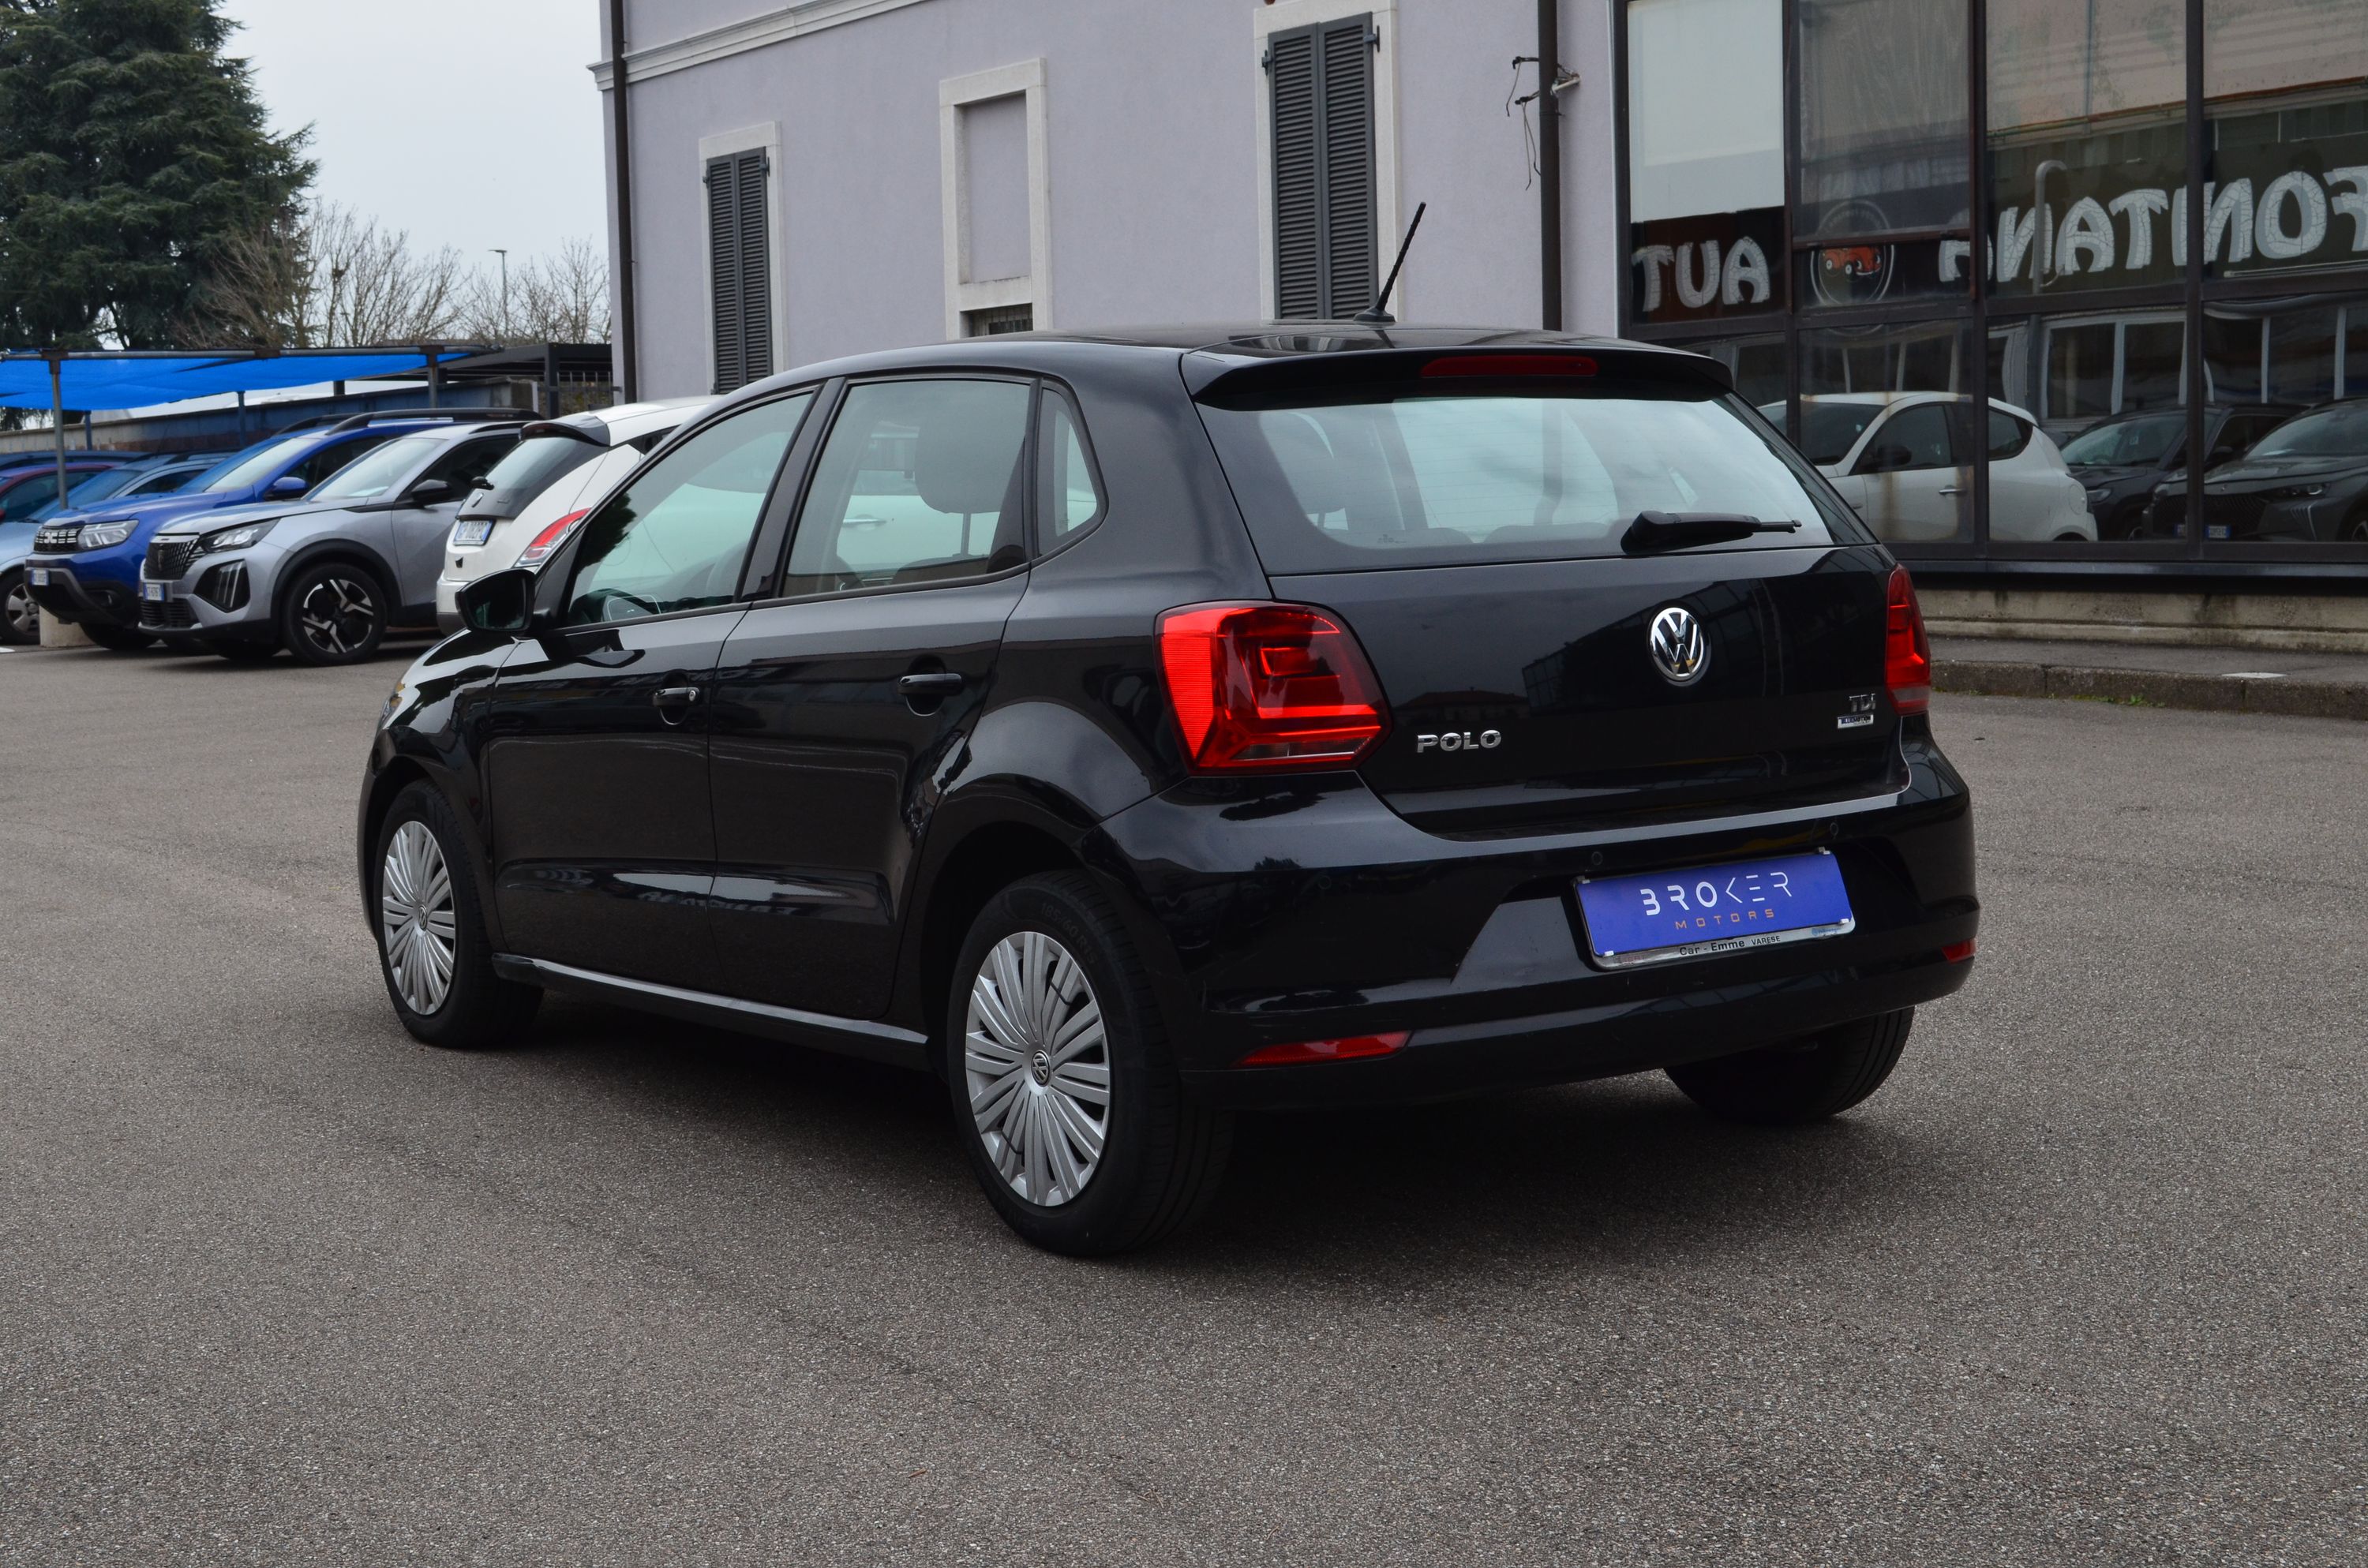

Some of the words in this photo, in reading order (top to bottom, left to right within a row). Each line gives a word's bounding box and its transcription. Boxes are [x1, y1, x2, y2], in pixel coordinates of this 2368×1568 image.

[1417, 729, 1502, 754] POLO
[1639, 871, 1793, 916] BROKER
[1674, 908, 1775, 930] MOTORS
[1679, 945, 1700, 956] Car
[1710, 939, 1745, 952] Emme
[1751, 935, 1782, 945] VARESE
